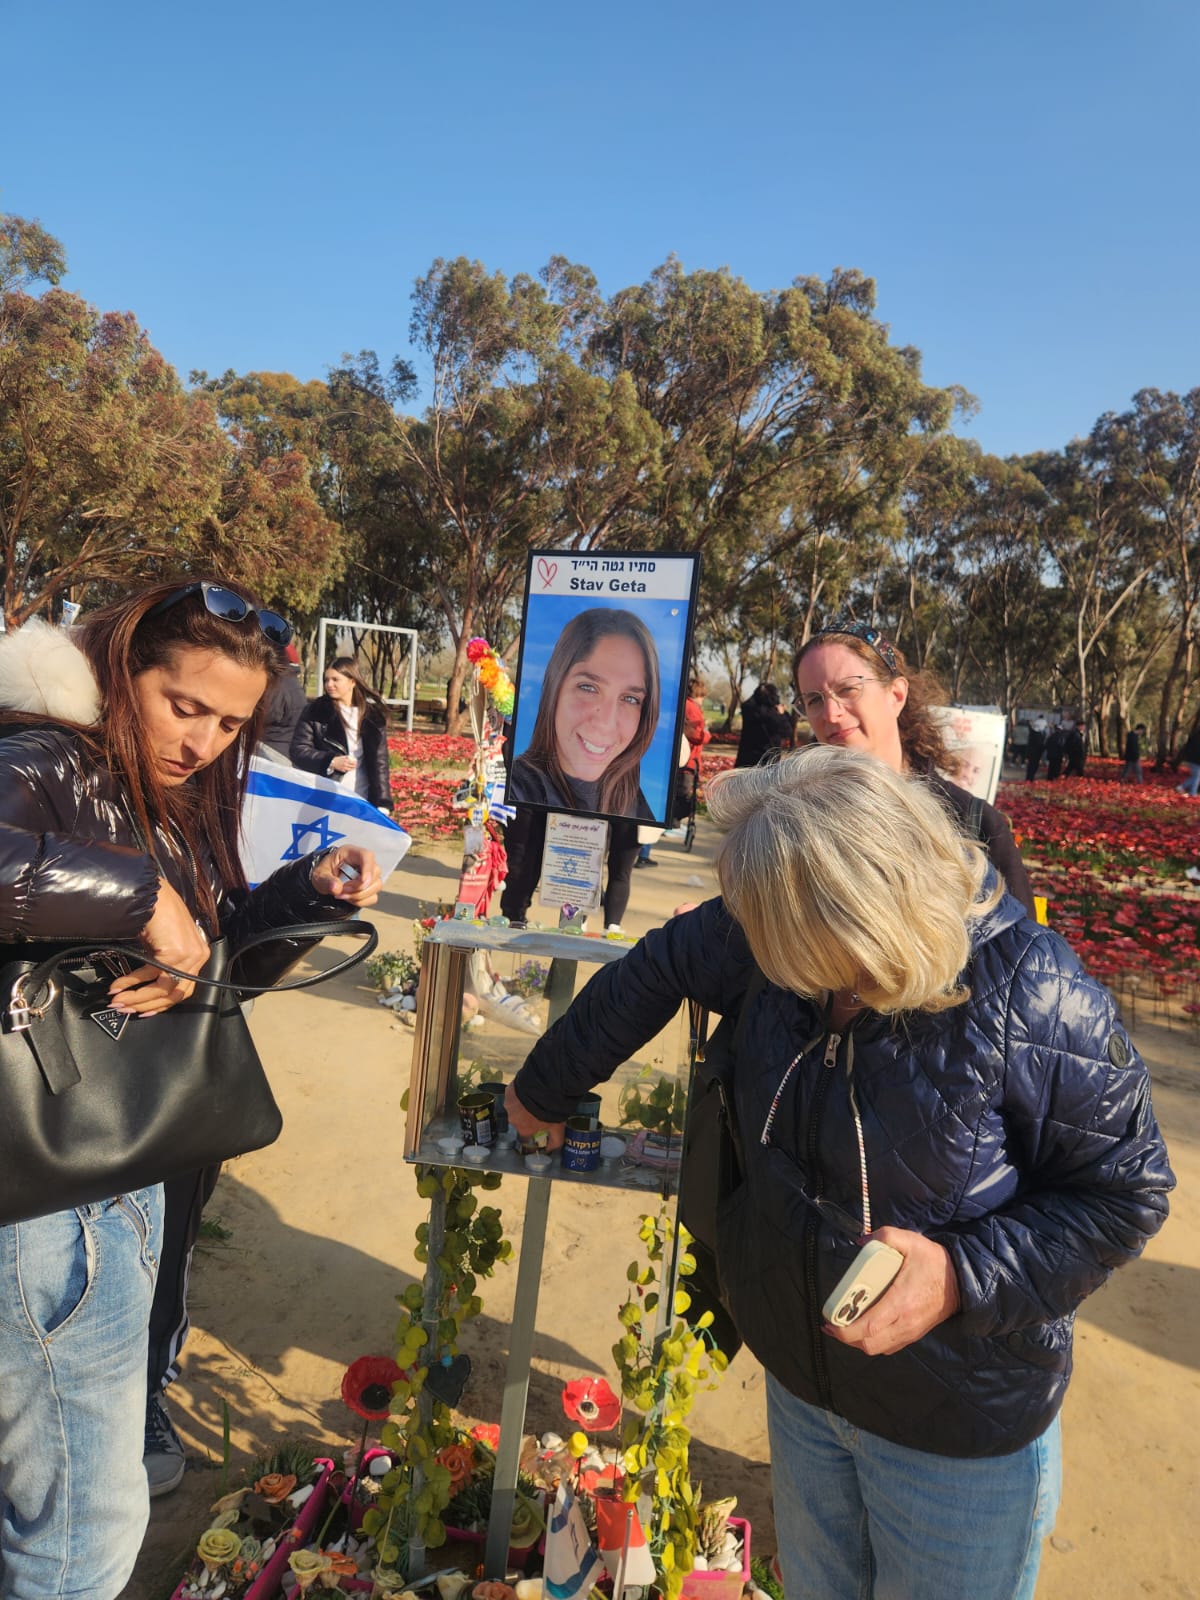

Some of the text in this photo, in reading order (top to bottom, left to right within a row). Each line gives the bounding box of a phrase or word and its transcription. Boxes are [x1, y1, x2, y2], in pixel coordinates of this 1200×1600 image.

[602, 561, 625, 572] גטה
[629, 561, 656, 573] סתיו
[569, 577, 647, 593] Stav Geta
[99, 1011, 121, 1021] GUES
